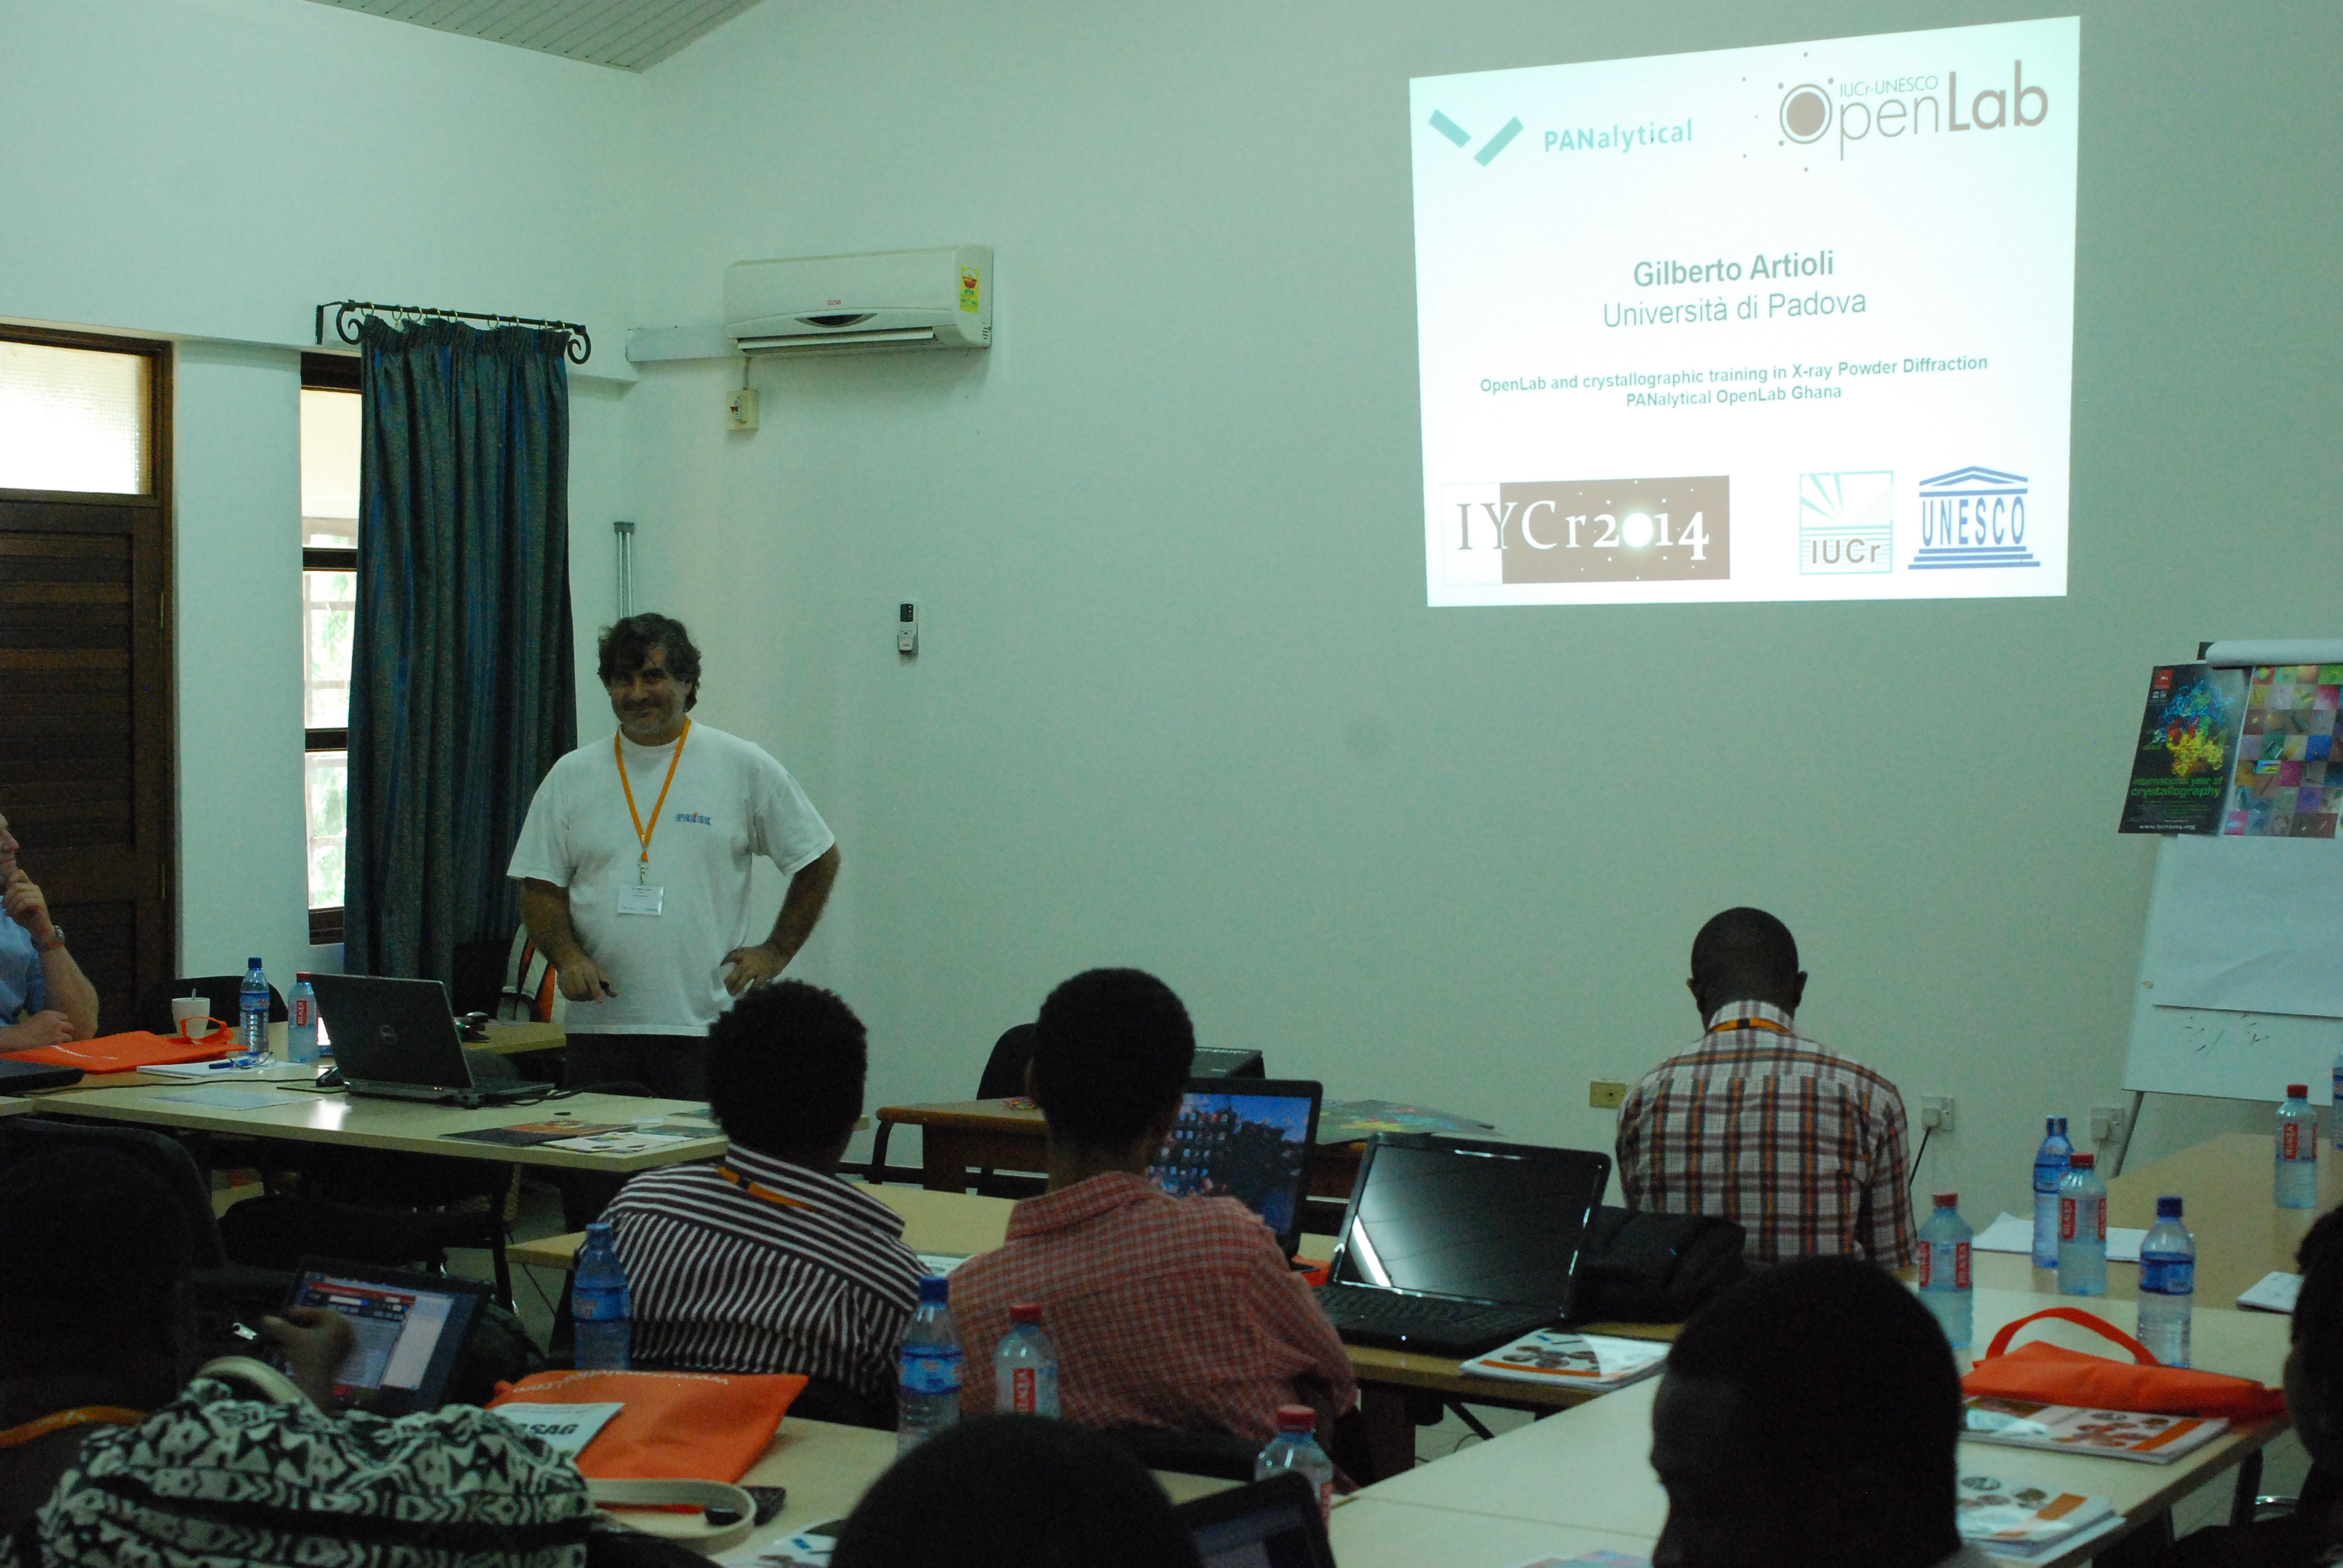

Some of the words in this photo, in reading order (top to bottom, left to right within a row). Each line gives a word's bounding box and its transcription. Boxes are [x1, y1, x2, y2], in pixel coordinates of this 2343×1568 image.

[1840, 74, 1938, 97] IUCr-UNESCO
[1779, 59, 2048, 161] OpenLab
[1544, 118, 1693, 153] PANalytical
[1633, 258, 1742, 287] Gilberto
[1749, 250, 1833, 280] Artioli
[1604, 296, 1728, 328] Università
[1737, 295, 1758, 320] di
[1769, 290, 1867, 318] Padova
[1480, 376, 1547, 394] OpenLab
[1551, 374, 1579, 389] and
[1582, 369, 1705, 390] crystallographic
[1709, 366, 1769, 384] training
[1773, 365, 1788, 379] in
[1792, 364, 1833, 381] X-ray
[1838, 360, 1898, 376] Powder
[1903, 356, 1988, 373] Diffraction
[1627, 390, 1712, 408] PANalytical
[1716, 387, 1787, 406] OpenLab
[1791, 385, 1842, 400] Ghana
[1457, 500, 1709, 561] IYCr2014
[1922, 496, 2025, 547] UNESCO
[1812, 538, 1881, 564] IUCr
